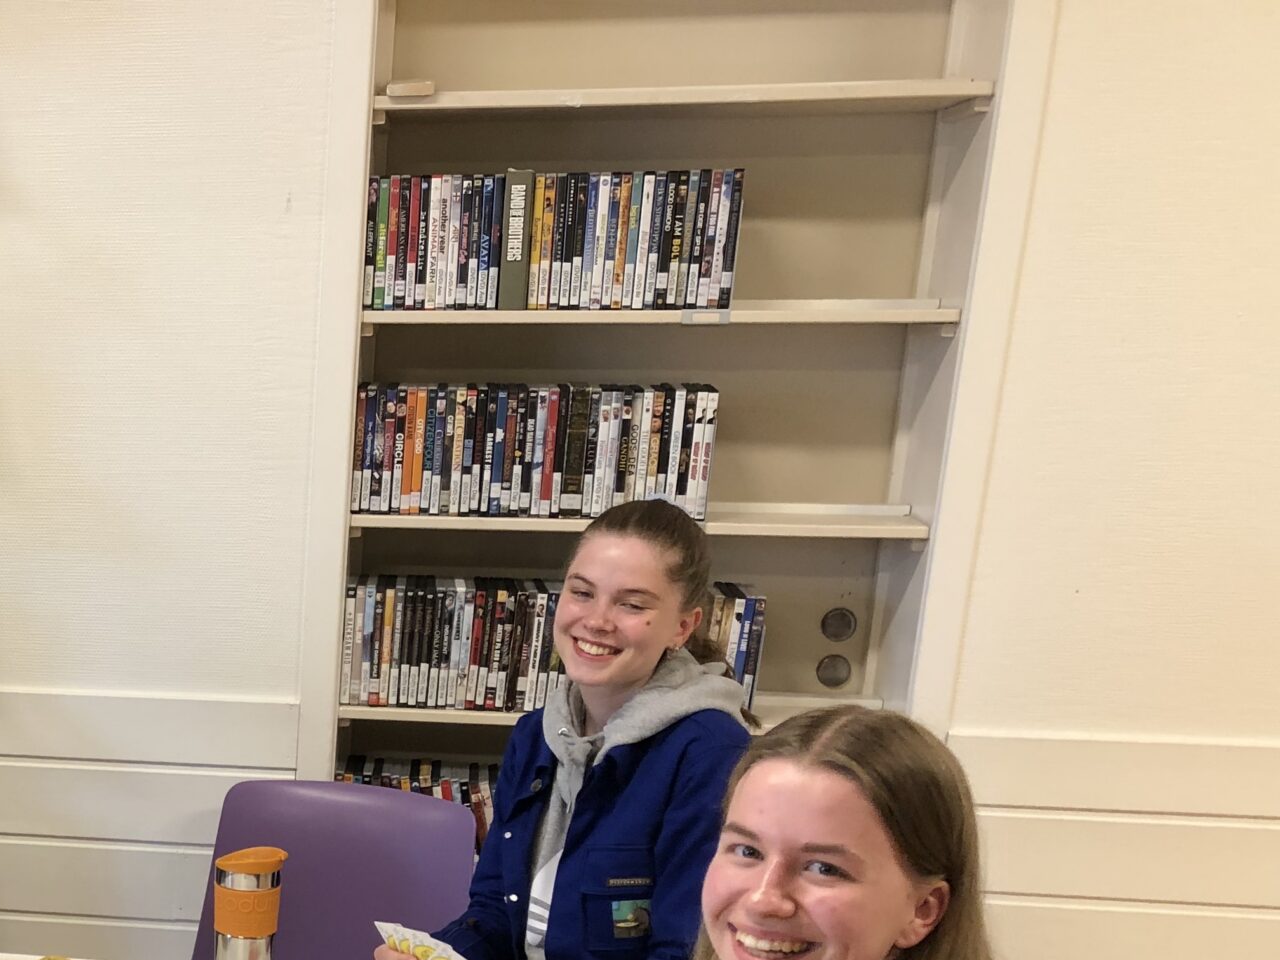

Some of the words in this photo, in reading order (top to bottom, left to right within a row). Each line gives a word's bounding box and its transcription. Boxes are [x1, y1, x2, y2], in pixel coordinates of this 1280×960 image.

[440, 198, 449, 232] another
[511, 184, 527, 209] BAND
[439, 232, 447, 255] year
[506, 217, 524, 262] BROTHERS
[674, 219, 683, 236] AM
[480, 233, 490, 271] AVATA
[662, 398, 671, 439] GRAVITY
[393, 432, 405, 471] CIRCLE
[423, 408, 436, 472] CITIZENFOUR
[619, 436, 628, 472] GANDHI
[649, 435, 659, 477] GRACE
[671, 430, 680, 456] GREEN
